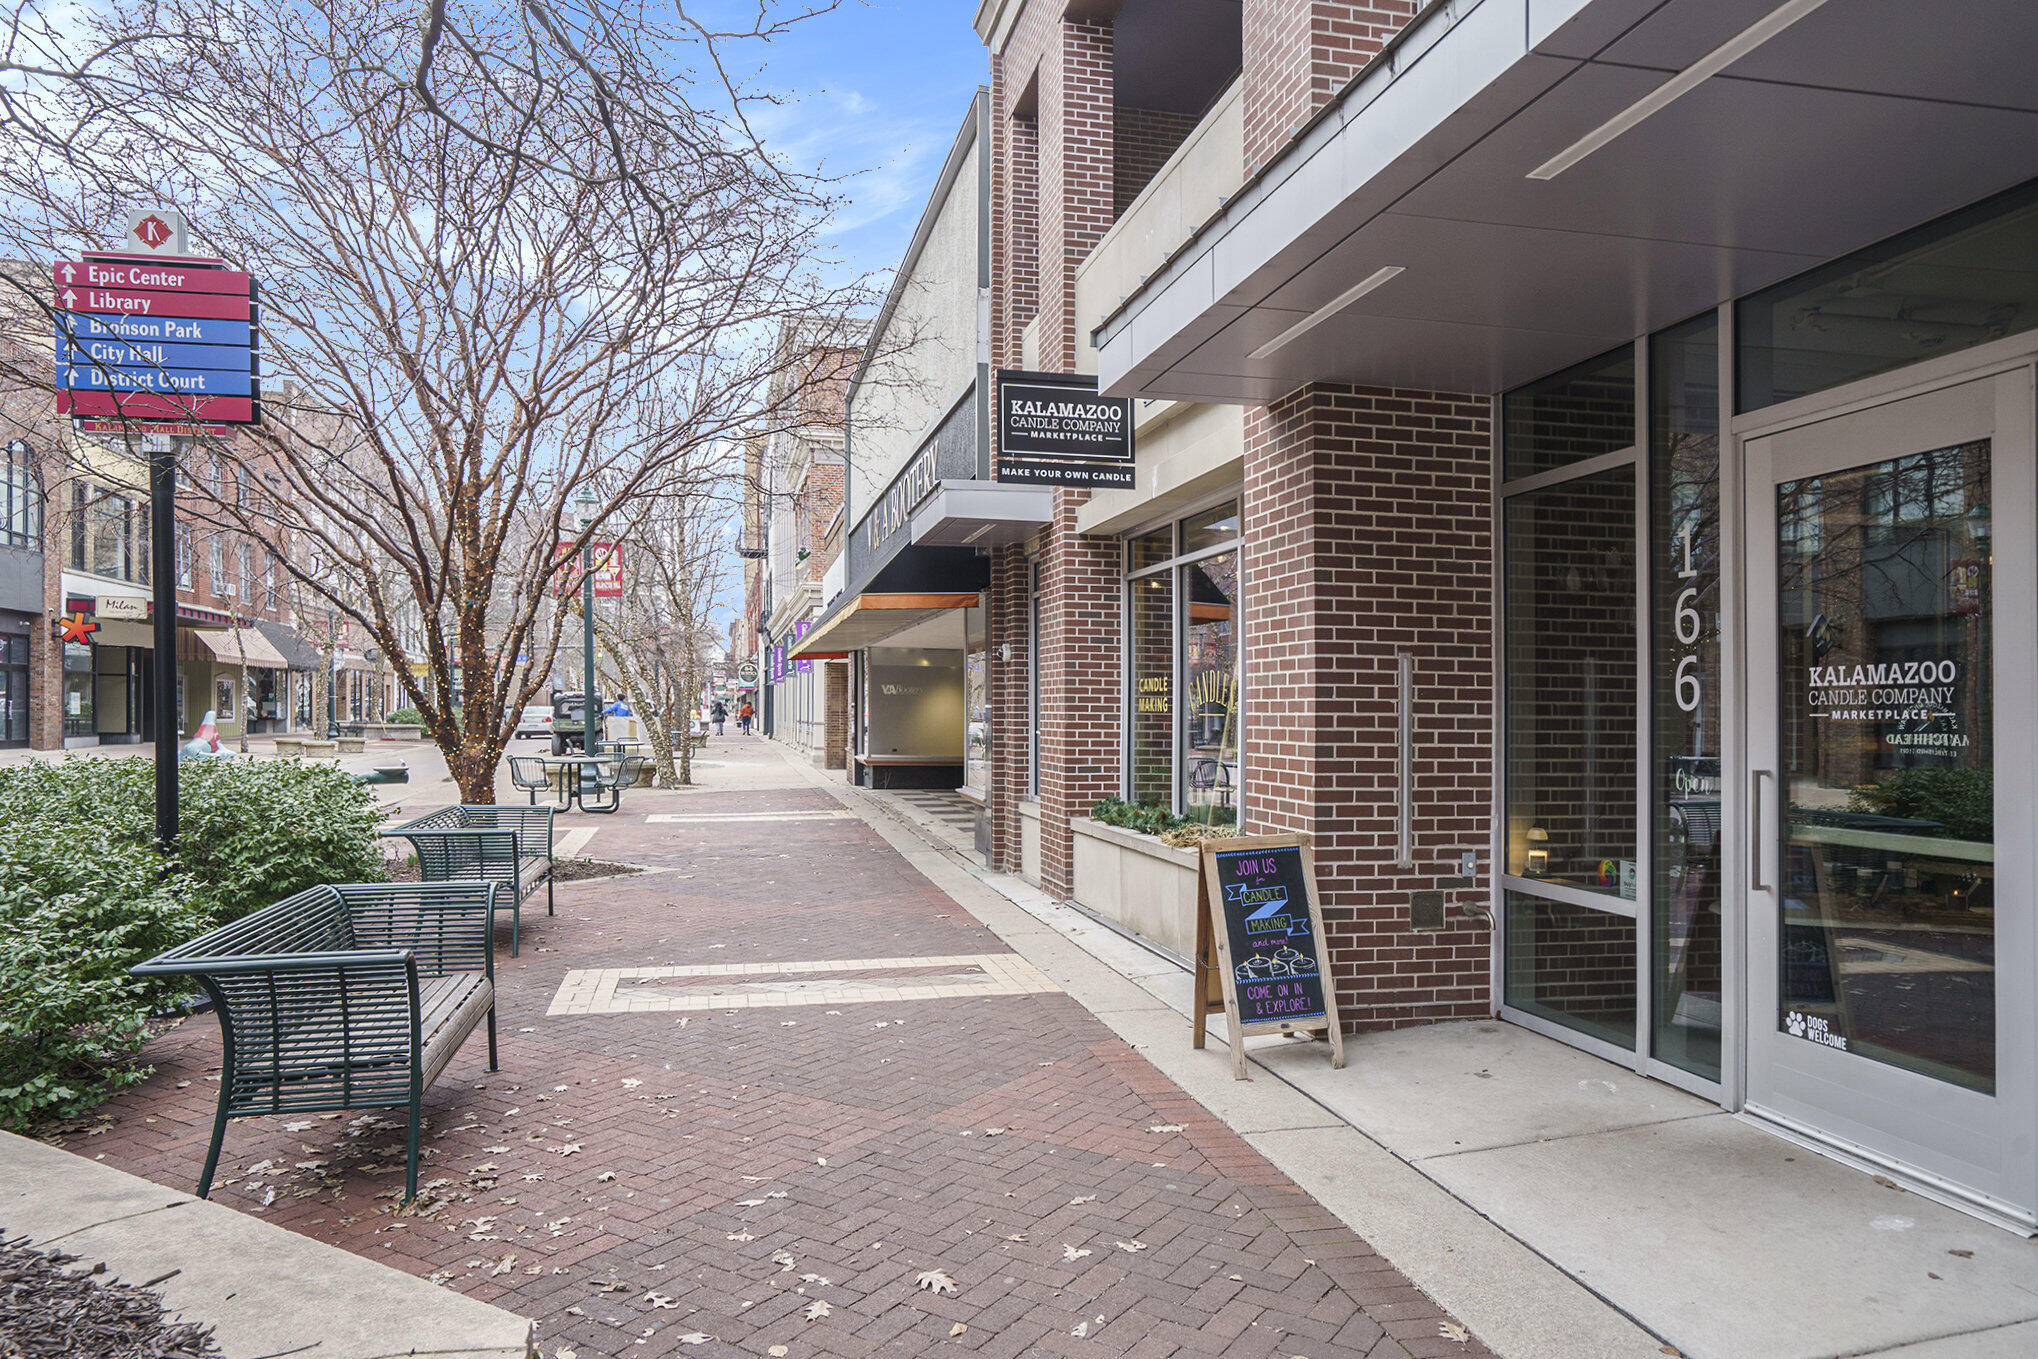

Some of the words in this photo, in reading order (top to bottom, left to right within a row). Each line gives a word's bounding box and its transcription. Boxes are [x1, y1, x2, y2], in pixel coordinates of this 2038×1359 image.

[88, 265, 125, 287] Epic
[129, 267, 186, 287] Center
[89, 291, 152, 315] Library
[90, 316, 160, 337] Bronson
[165, 320, 202, 339] Park
[91, 343, 125, 364] City
[130, 345, 163, 362] Hall
[91, 368, 154, 388] District
[158, 371, 206, 389] Court
[1010, 400, 1122, 421] KALAMAZOO
[1010, 416, 1059, 430] CANDLE
[1062, 419, 1121, 433] COMPANY
[1030, 431, 1104, 442] MARKETPLACE
[1001, 468, 1031, 477] MAKE
[1034, 469, 1062, 478] YOUR
[1065, 471, 1089, 480] OWN
[1092, 472, 1132, 482] CANDLE
[1808, 660, 1956, 687] KALAMAZOO
[1139, 676, 1168, 693] CANDLE
[1138, 697, 1168, 713] MAKING
[1808, 689, 1867, 706] CANDLE
[1872, 686, 1955, 705] COMPANY
[1831, 709, 1928, 721] MARKETPLACE
[1675, 768, 1713, 801] Open
[1236, 859, 1259, 876] JOIN
[1261, 857, 1277, 874] US
[1243, 888, 1282, 903] CANDLE
[1250, 917, 1287, 931] MAKING
[1252, 938, 1269, 948] and
[1247, 985, 1273, 1000] COME
[1277, 984, 1289, 997] ON
[1293, 982, 1303, 996] IN
[1256, 1002, 1264, 1015] &
[1807, 1015, 1828, 1032] DOGS
[1807, 1028, 1846, 1050] WELCOME
